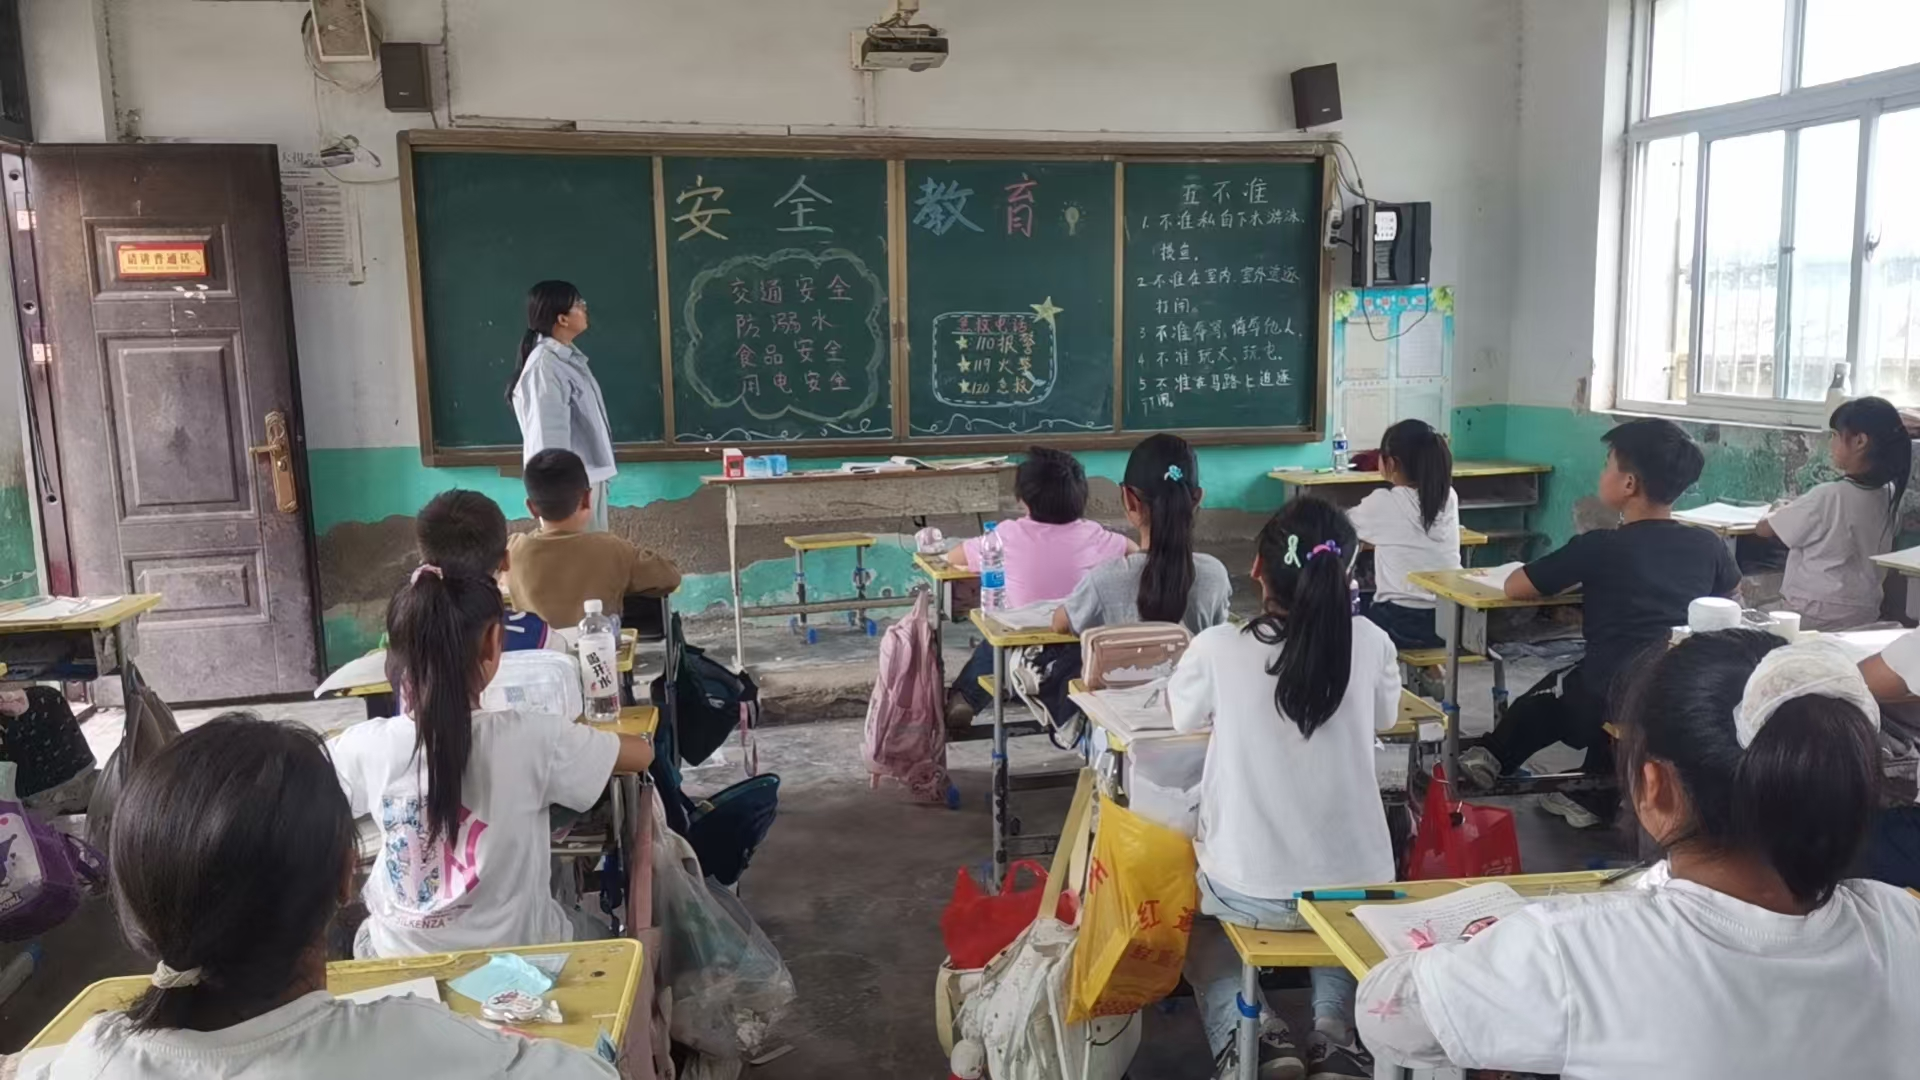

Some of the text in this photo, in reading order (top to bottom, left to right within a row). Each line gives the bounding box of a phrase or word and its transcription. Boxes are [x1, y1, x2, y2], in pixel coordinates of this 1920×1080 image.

[1182, 177, 1268, 204] 五不准
[729, 274, 853, 304] 交通安全
[735, 310, 835, 338] 防溺水
[736, 339, 845, 368] 食品安全
[742, 371, 850, 397] 用电安全
